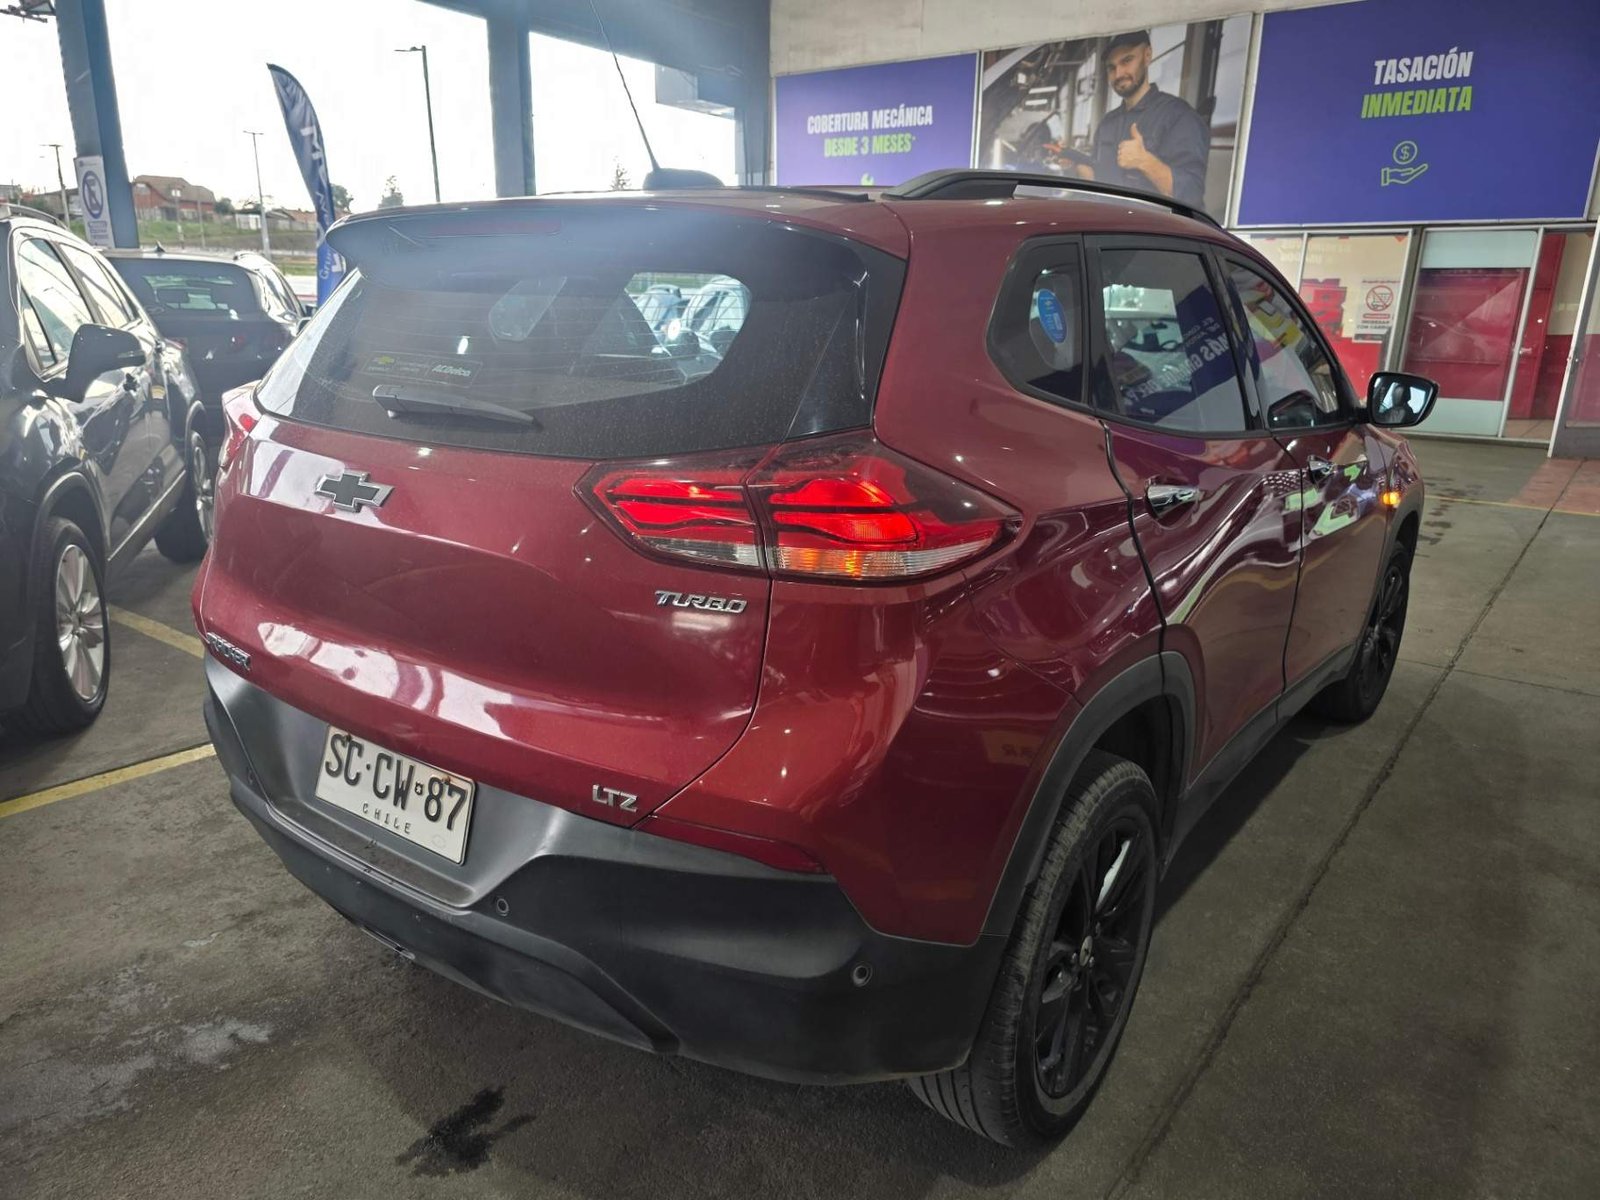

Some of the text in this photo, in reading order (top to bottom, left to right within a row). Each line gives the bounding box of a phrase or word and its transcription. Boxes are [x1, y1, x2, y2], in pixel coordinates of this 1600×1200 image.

[1374, 46, 1474, 85] TASACIÓN
[1361, 86, 1472, 118] INMEDIATA
[807, 103, 933, 134] COBERTURA MECÁNICA
[824, 136, 858, 158] DESDE
[860, 136, 869, 155] 3
[655, 590, 747, 613] TURBO
[592, 784, 638, 812] LTZ
[362, 803, 411, 835] CHILE
